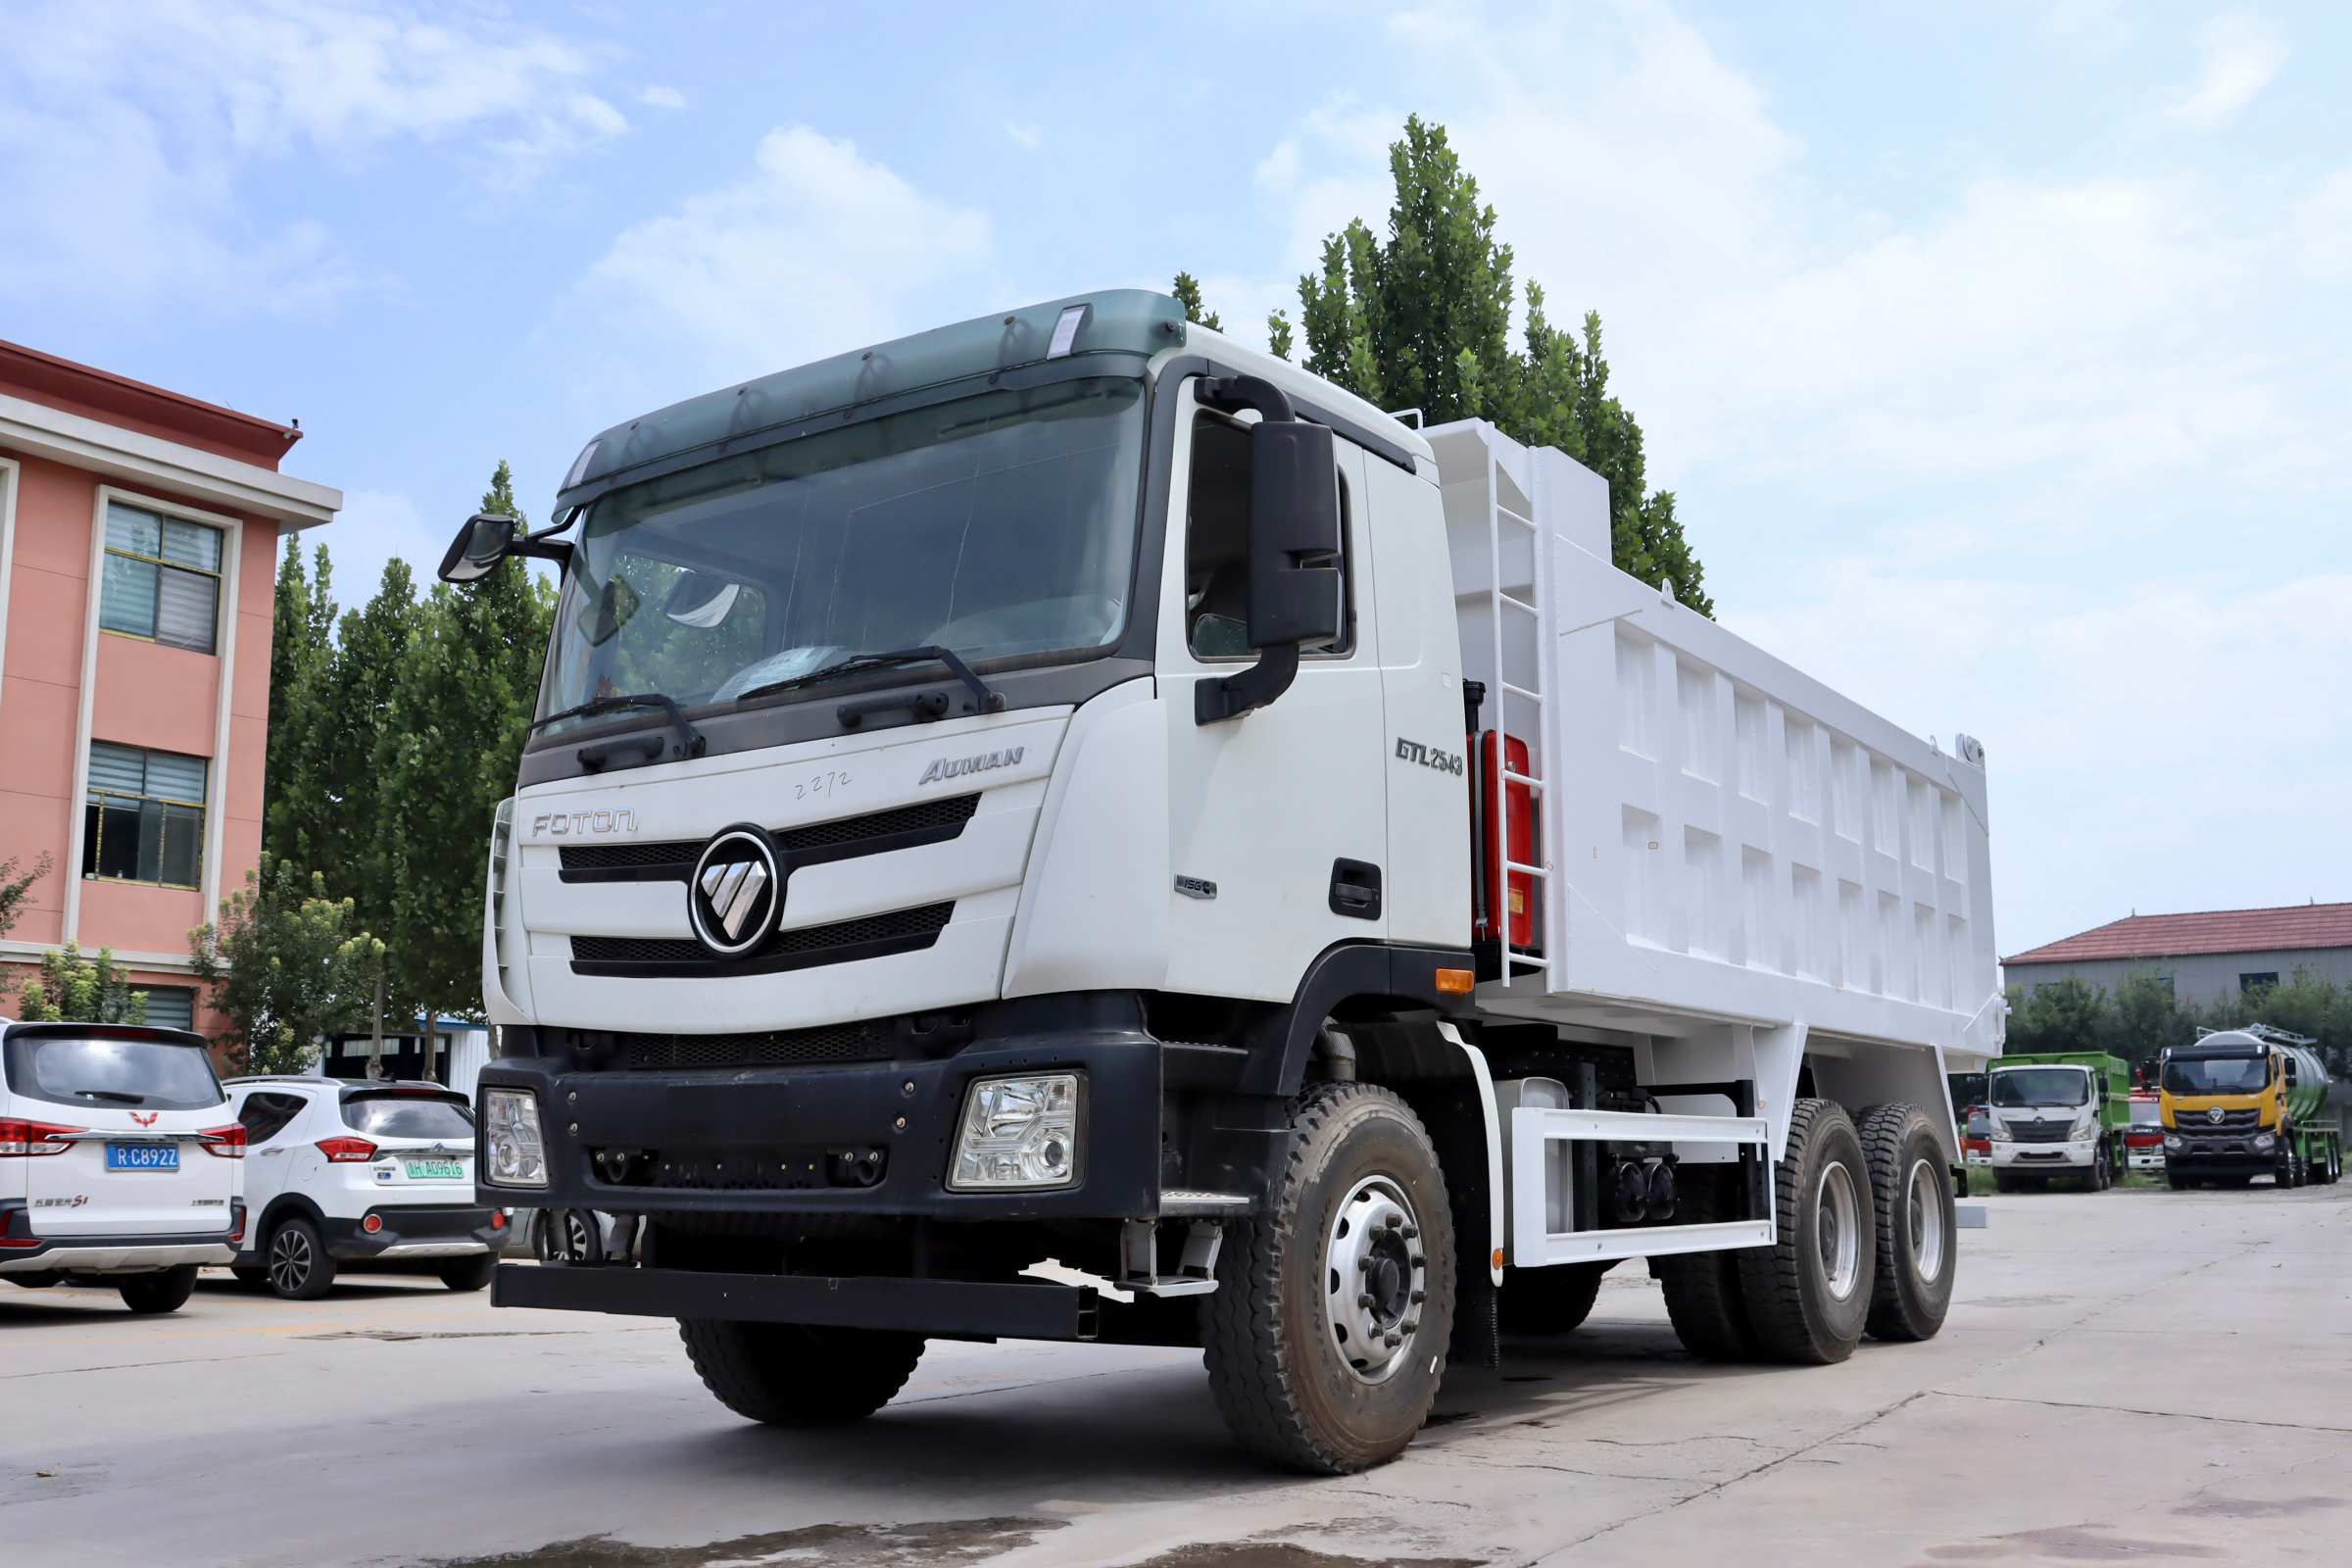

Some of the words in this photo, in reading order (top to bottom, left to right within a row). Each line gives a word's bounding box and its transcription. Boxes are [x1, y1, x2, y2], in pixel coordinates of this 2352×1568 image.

[918, 747, 1024, 785] AUMAN
[1396, 737, 1463, 776] GTL2543
[795, 771, 853, 800] 2272
[532, 808, 634, 837] FOTON
